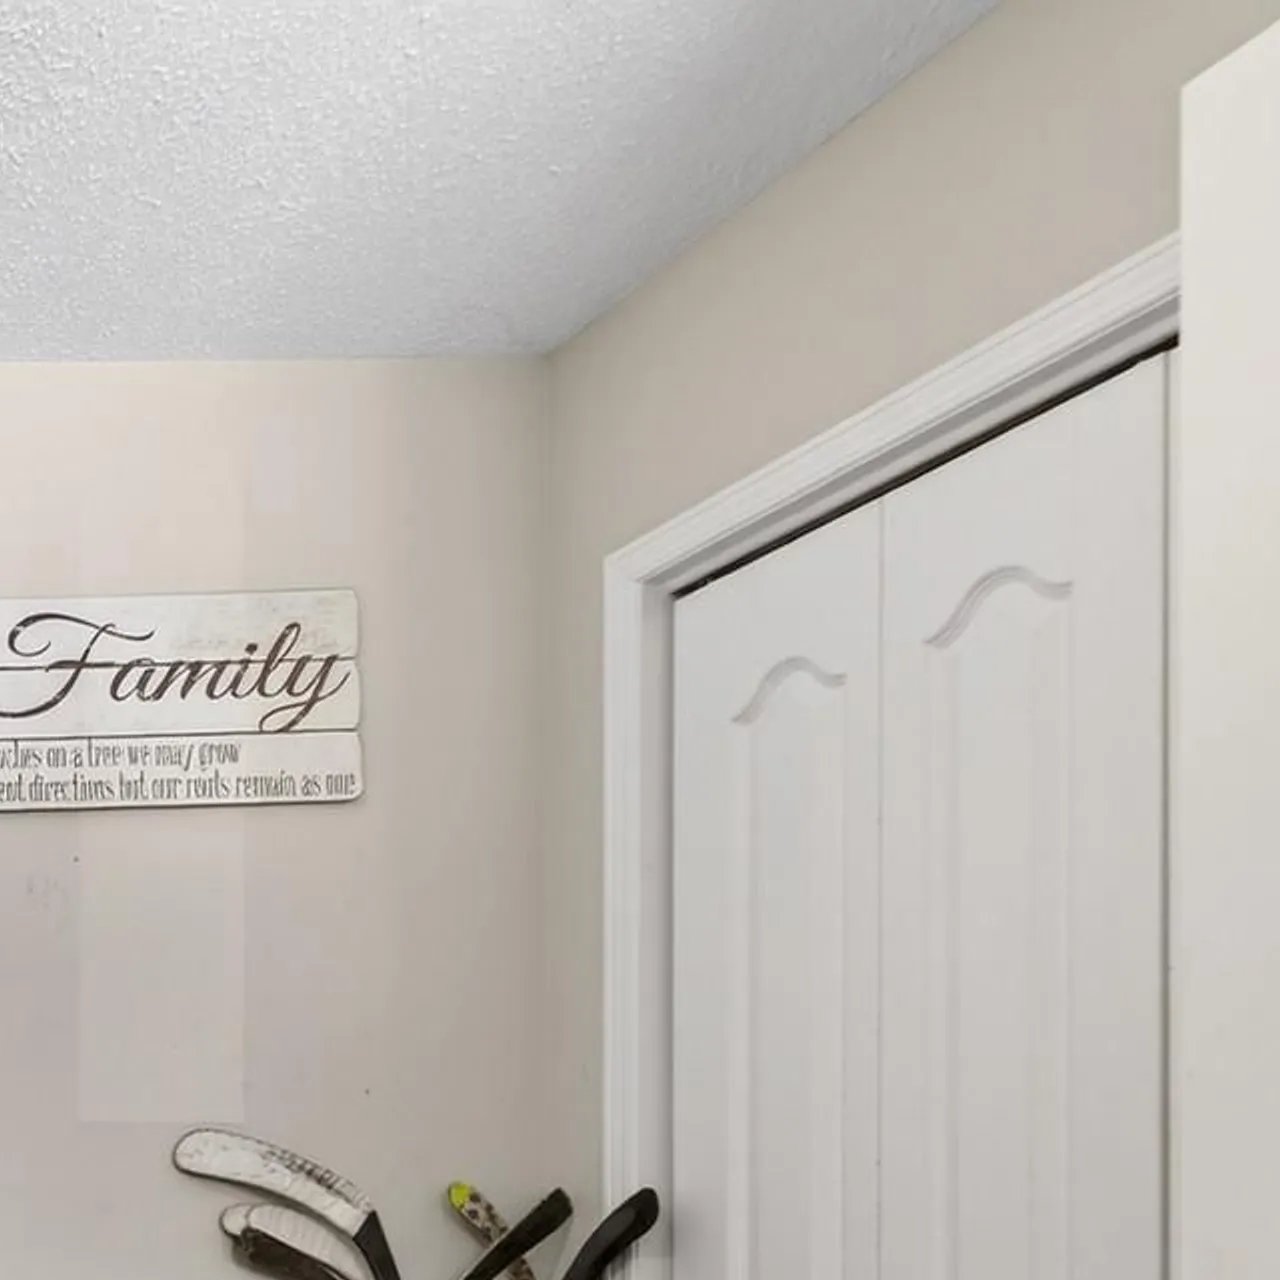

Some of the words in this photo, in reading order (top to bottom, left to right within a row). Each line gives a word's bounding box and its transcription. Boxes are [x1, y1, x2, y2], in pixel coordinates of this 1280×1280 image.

[46, 747, 67, 768] on
[69, 749, 83, 768] a
[87, 738, 124, 767] tree
[126, 744, 151, 767] we
[154, 742, 194, 772] may
[197, 742, 241, 771] grow
[28, 772, 115, 802] directions
[118, 769, 148, 800] but
[151, 777, 182, 800] our
[235, 768, 296, 798] remain
[300, 773, 322, 797] as
[324, 771, 356, 796] one
